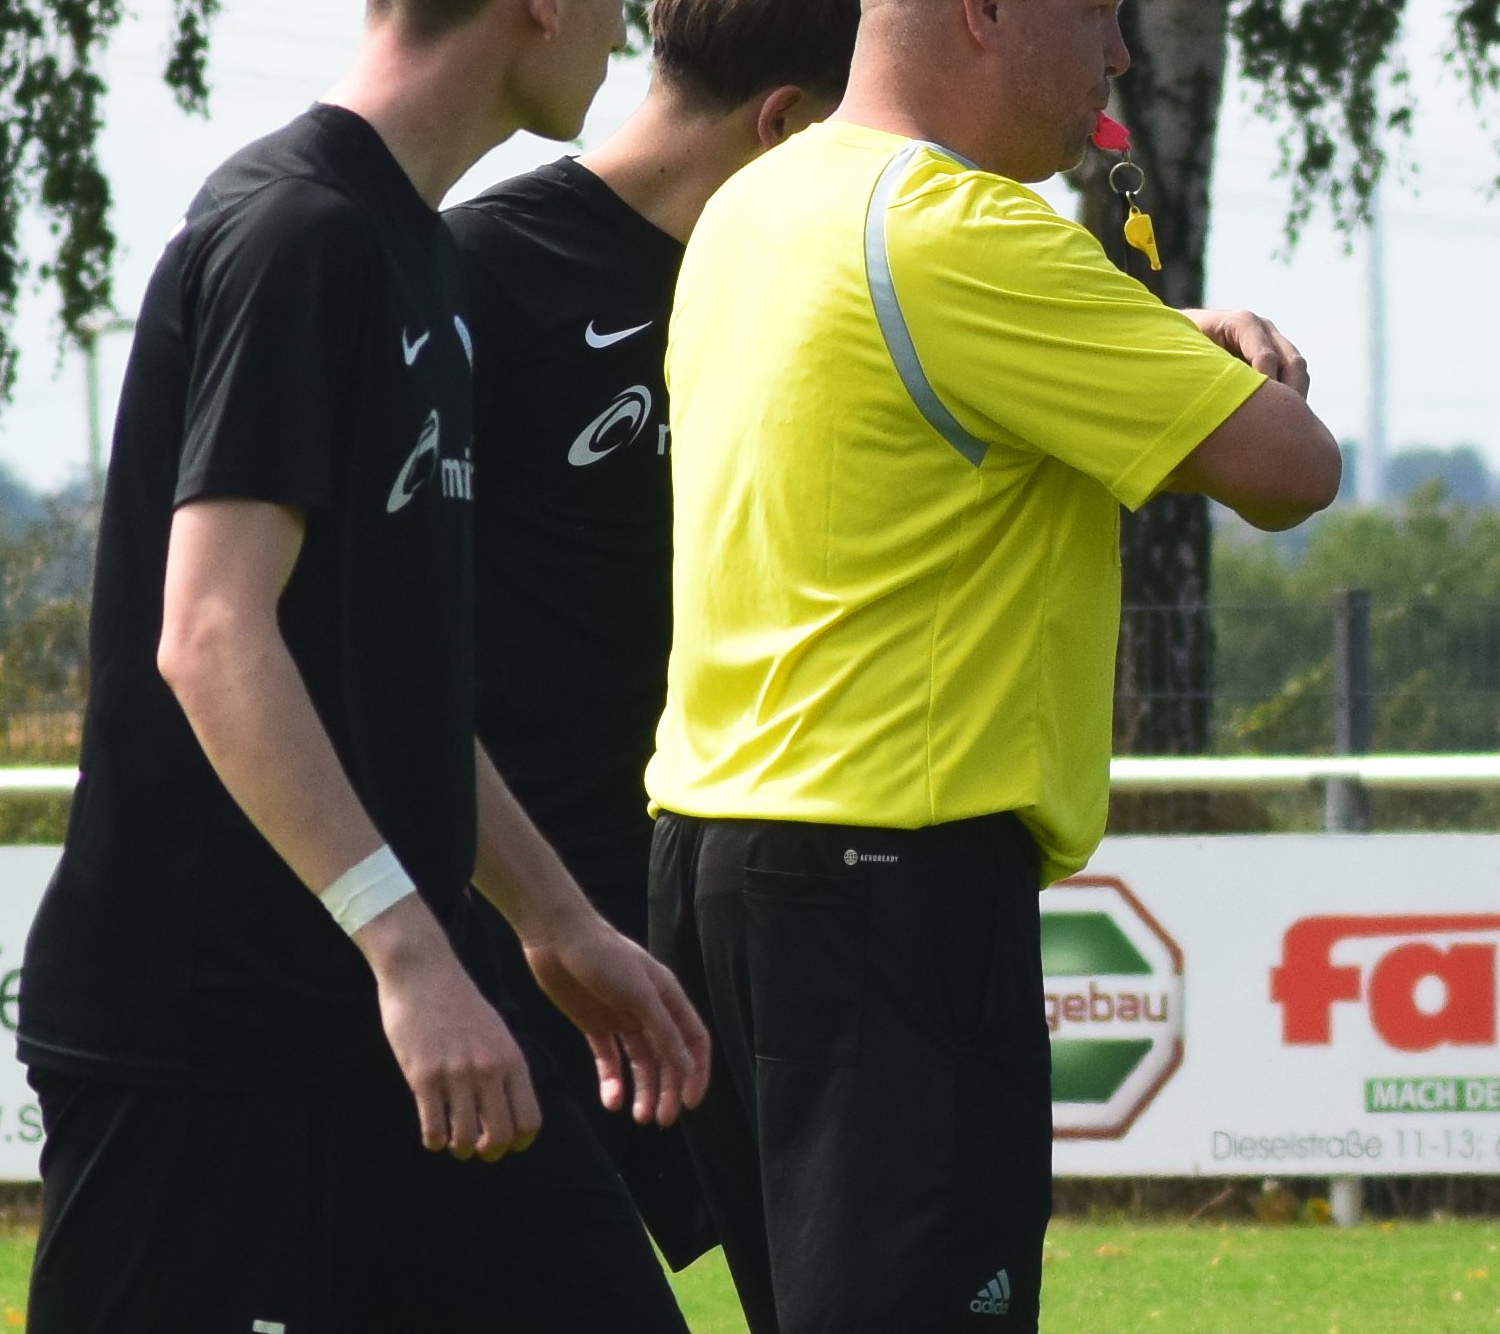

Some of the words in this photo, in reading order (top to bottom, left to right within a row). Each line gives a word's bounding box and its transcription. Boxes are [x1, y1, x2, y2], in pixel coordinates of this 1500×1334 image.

[1044, 981, 1169, 1032] gebau
[1372, 1081, 1456, 1110] MACH
[1211, 1129, 1383, 1161] Dieselstraße
